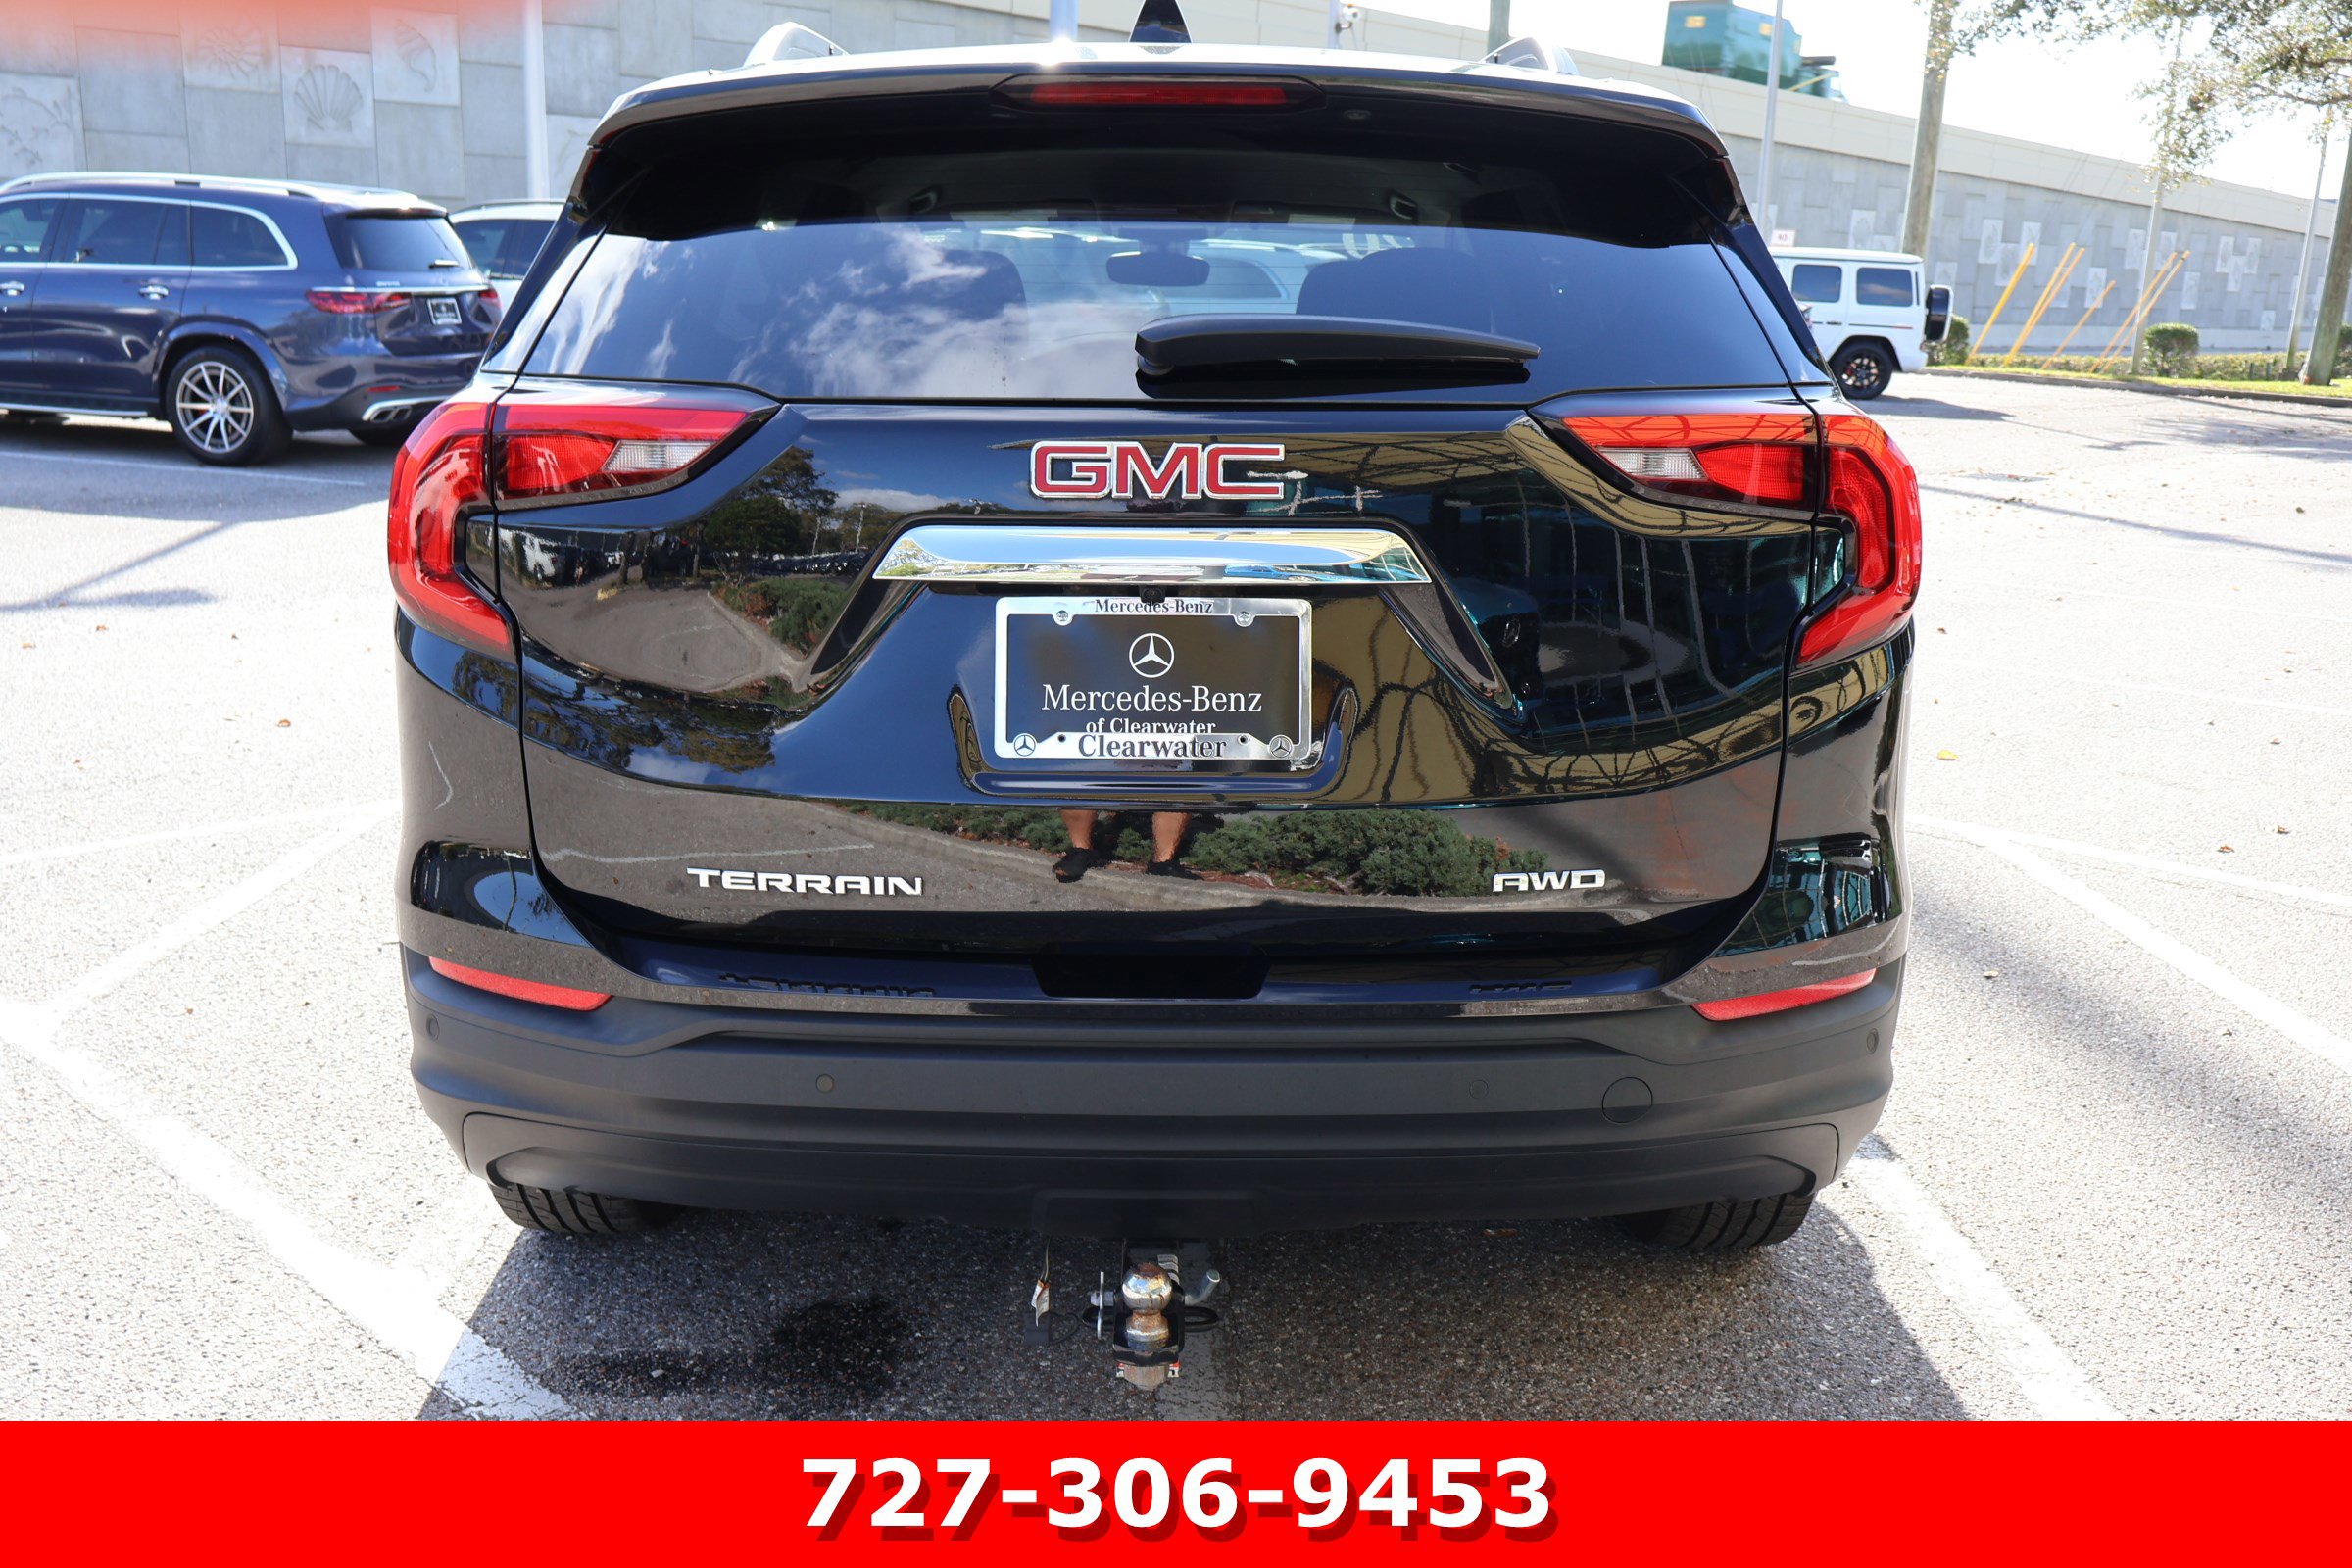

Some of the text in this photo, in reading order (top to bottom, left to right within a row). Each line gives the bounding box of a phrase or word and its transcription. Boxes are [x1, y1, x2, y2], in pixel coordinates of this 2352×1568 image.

[1031, 441, 1285, 500] GMC
[1095, 598, 1213, 613] Mercedes-Benz
[1042, 684, 1263, 712] Mercedes-Benz
[1086, 717, 1217, 734] of Clearwater
[1078, 734, 1227, 758] Clearwater
[687, 867, 923, 896] TERRAIN
[1493, 869, 1605, 893] AWD
